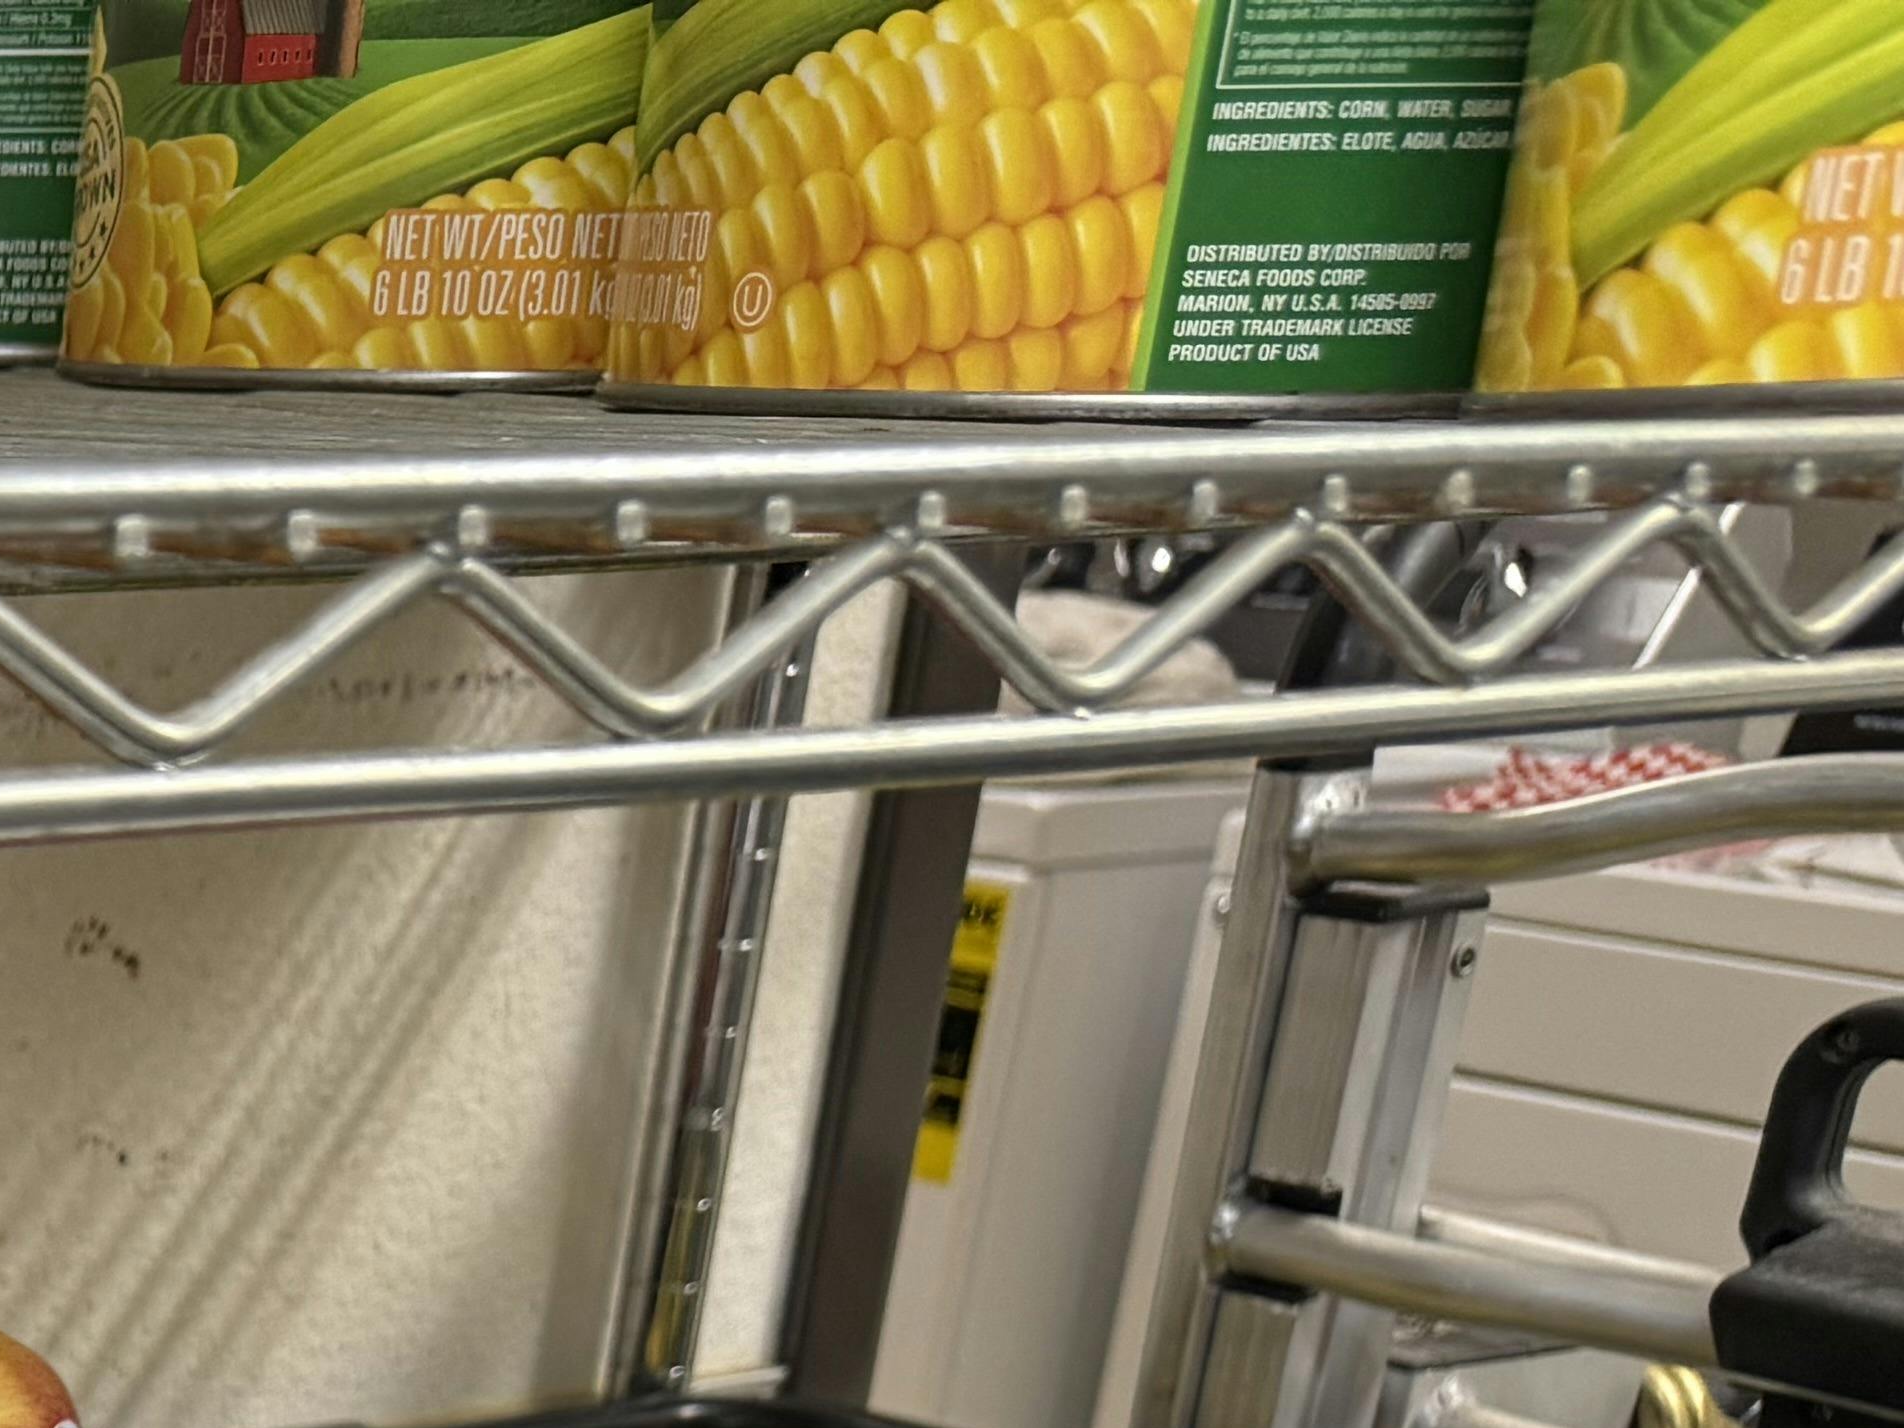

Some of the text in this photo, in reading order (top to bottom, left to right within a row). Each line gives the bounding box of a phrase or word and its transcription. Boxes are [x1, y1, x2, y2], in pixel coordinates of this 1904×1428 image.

[1212, 101, 1334, 120] INGREDIENTS:
[1338, 100, 1389, 120] CORN,
[1396, 99, 1454, 119] WATER,
[1206, 133, 1337, 152] INGREDIENTES:
[1341, 132, 1396, 153] ELOTE,
[1400, 131, 1448, 151] AGUA,
[1802, 152, 1886, 223] NET
[385, 211, 622, 261] NET WT/PESO NET
[667, 211, 710, 262] NETO
[1186, 242, 1472, 263] DISTRIBUTED BY/DISTRIBUIDO POR
[1181, 268, 1368, 288] SENECA FOODS CORP.
[1780, 236, 1812, 305] 6
[1813, 233, 1871, 302] LB
[372, 269, 391, 316] 6
[396, 271, 432, 316] LB
[441, 270, 471, 316] 10
[477, 270, 513, 315] OZ
[518, 269, 582, 321] (3.01
[672, 273, 702, 331] kg)
[1177, 294, 1255, 314] MARION,
[1261, 294, 1287, 312] NY
[1291, 293, 1343, 312] U.S.A.
[1173, 317, 1415, 338] UNDER TRADEMARK LICENSE
[1167, 343, 1321, 363] PRODUCT OF USA
